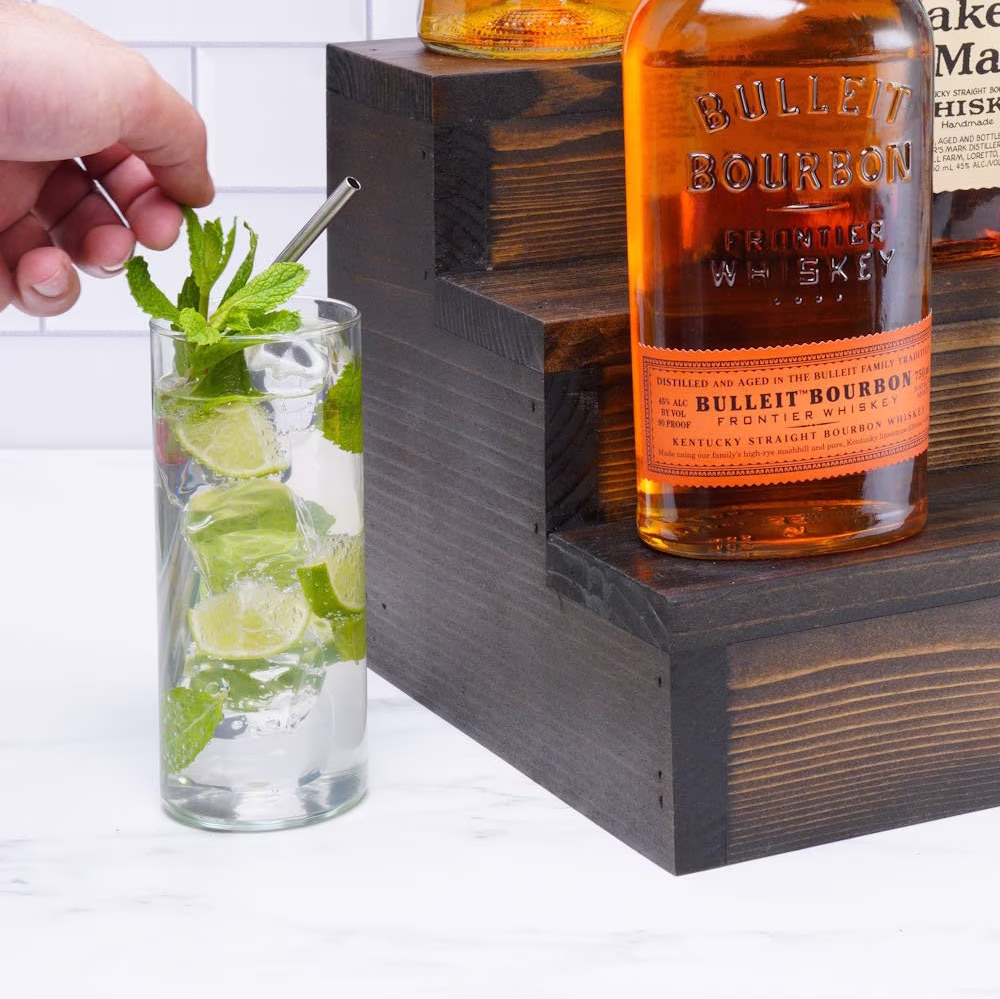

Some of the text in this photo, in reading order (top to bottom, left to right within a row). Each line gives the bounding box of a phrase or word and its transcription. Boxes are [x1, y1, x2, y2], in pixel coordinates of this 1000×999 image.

[694, 75, 912, 133] BULLEIT
[953, 87, 986, 96] STRAIGHT
[942, 118, 994, 129] Handmade
[938, 136, 958, 145] AGED
[959, 135, 974, 143] AND
[945, 144, 967, 153] MARK
[687, 140, 912, 193] BOURBON
[956, 162, 970, 170] 45%
[724, 219, 886, 251] FRONTIER
[711, 249, 895, 287] WHSKEY
[657, 377, 708, 388] DISTILLED
[738, 377, 769, 386] AGED
[788, 373, 810, 383] THE
[814, 367, 857, 380] BULLEIT
[861, 358, 895, 374] FAMILY
[810, 370, 911, 405] BOURBON
[661, 409, 686, 418] BY VOL
[672, 399, 688, 407] ALC
[718, 395, 898, 426] FRONTIER WHISKEY
[666, 420, 691, 429] PROOF
[672, 406, 925, 447] KENTUCKY STRAIGHT BOURBON WHISKEY
[712, 449, 741, 460] family's
[744, 449, 775, 459] high-rye
[811, 443, 825, 452] and
[847, 434, 878, 446] Kentucky
